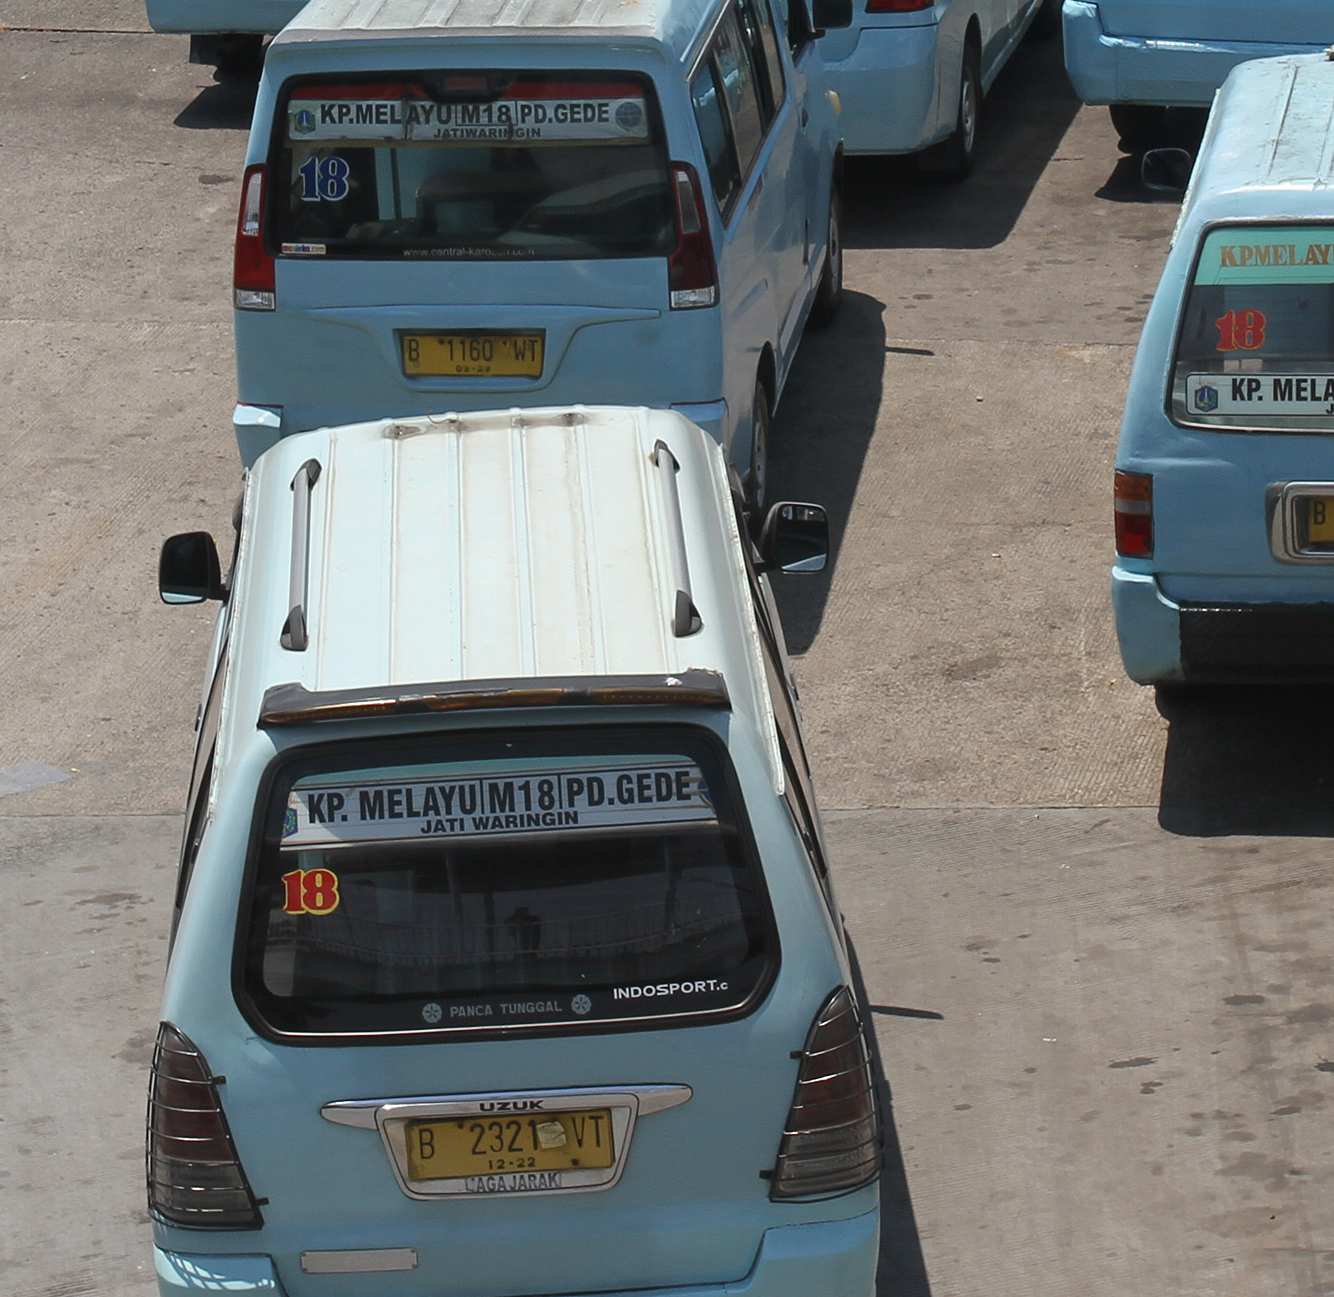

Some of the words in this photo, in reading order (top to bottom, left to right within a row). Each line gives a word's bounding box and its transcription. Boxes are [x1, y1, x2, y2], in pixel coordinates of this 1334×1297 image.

[320, 103, 452, 126] KP.MELAYU
[460, 103, 510, 126] M18
[520, 102, 610, 125] PD.GEDE
[298, 156, 350, 202] 18
[1215, 308, 1267, 352] 18
[408, 338, 420, 362] B
[446, 338, 494, 362] 1160
[513, 338, 540, 362] WT
[1231, 379, 1263, 402] KP.
[1312, 503, 1326, 527] B
[308, 793, 349, 825] KP.
[360, 785, 477, 821] MELAYU
[488, 779, 555, 814] M18
[567, 771, 691, 809] PD.GEDE
[421, 818, 465, 834] JATI
[473, 811, 579, 832] WARINGIN
[282, 868, 340, 916] 18
[613, 979, 729, 1000] INDOSPORT.c
[449, 1004, 493, 1019] PANCA
[500, 1001, 563, 1016] TUNGGAL
[478, 1099, 544, 1113] UZUK
[418, 1128, 436, 1160] B
[469, 1120, 540, 1156] 2321
[572, 1114, 604, 1149] VT
[487, 1157, 537, 1171] 12-22
[509, 1172, 560, 1192] JARAK
